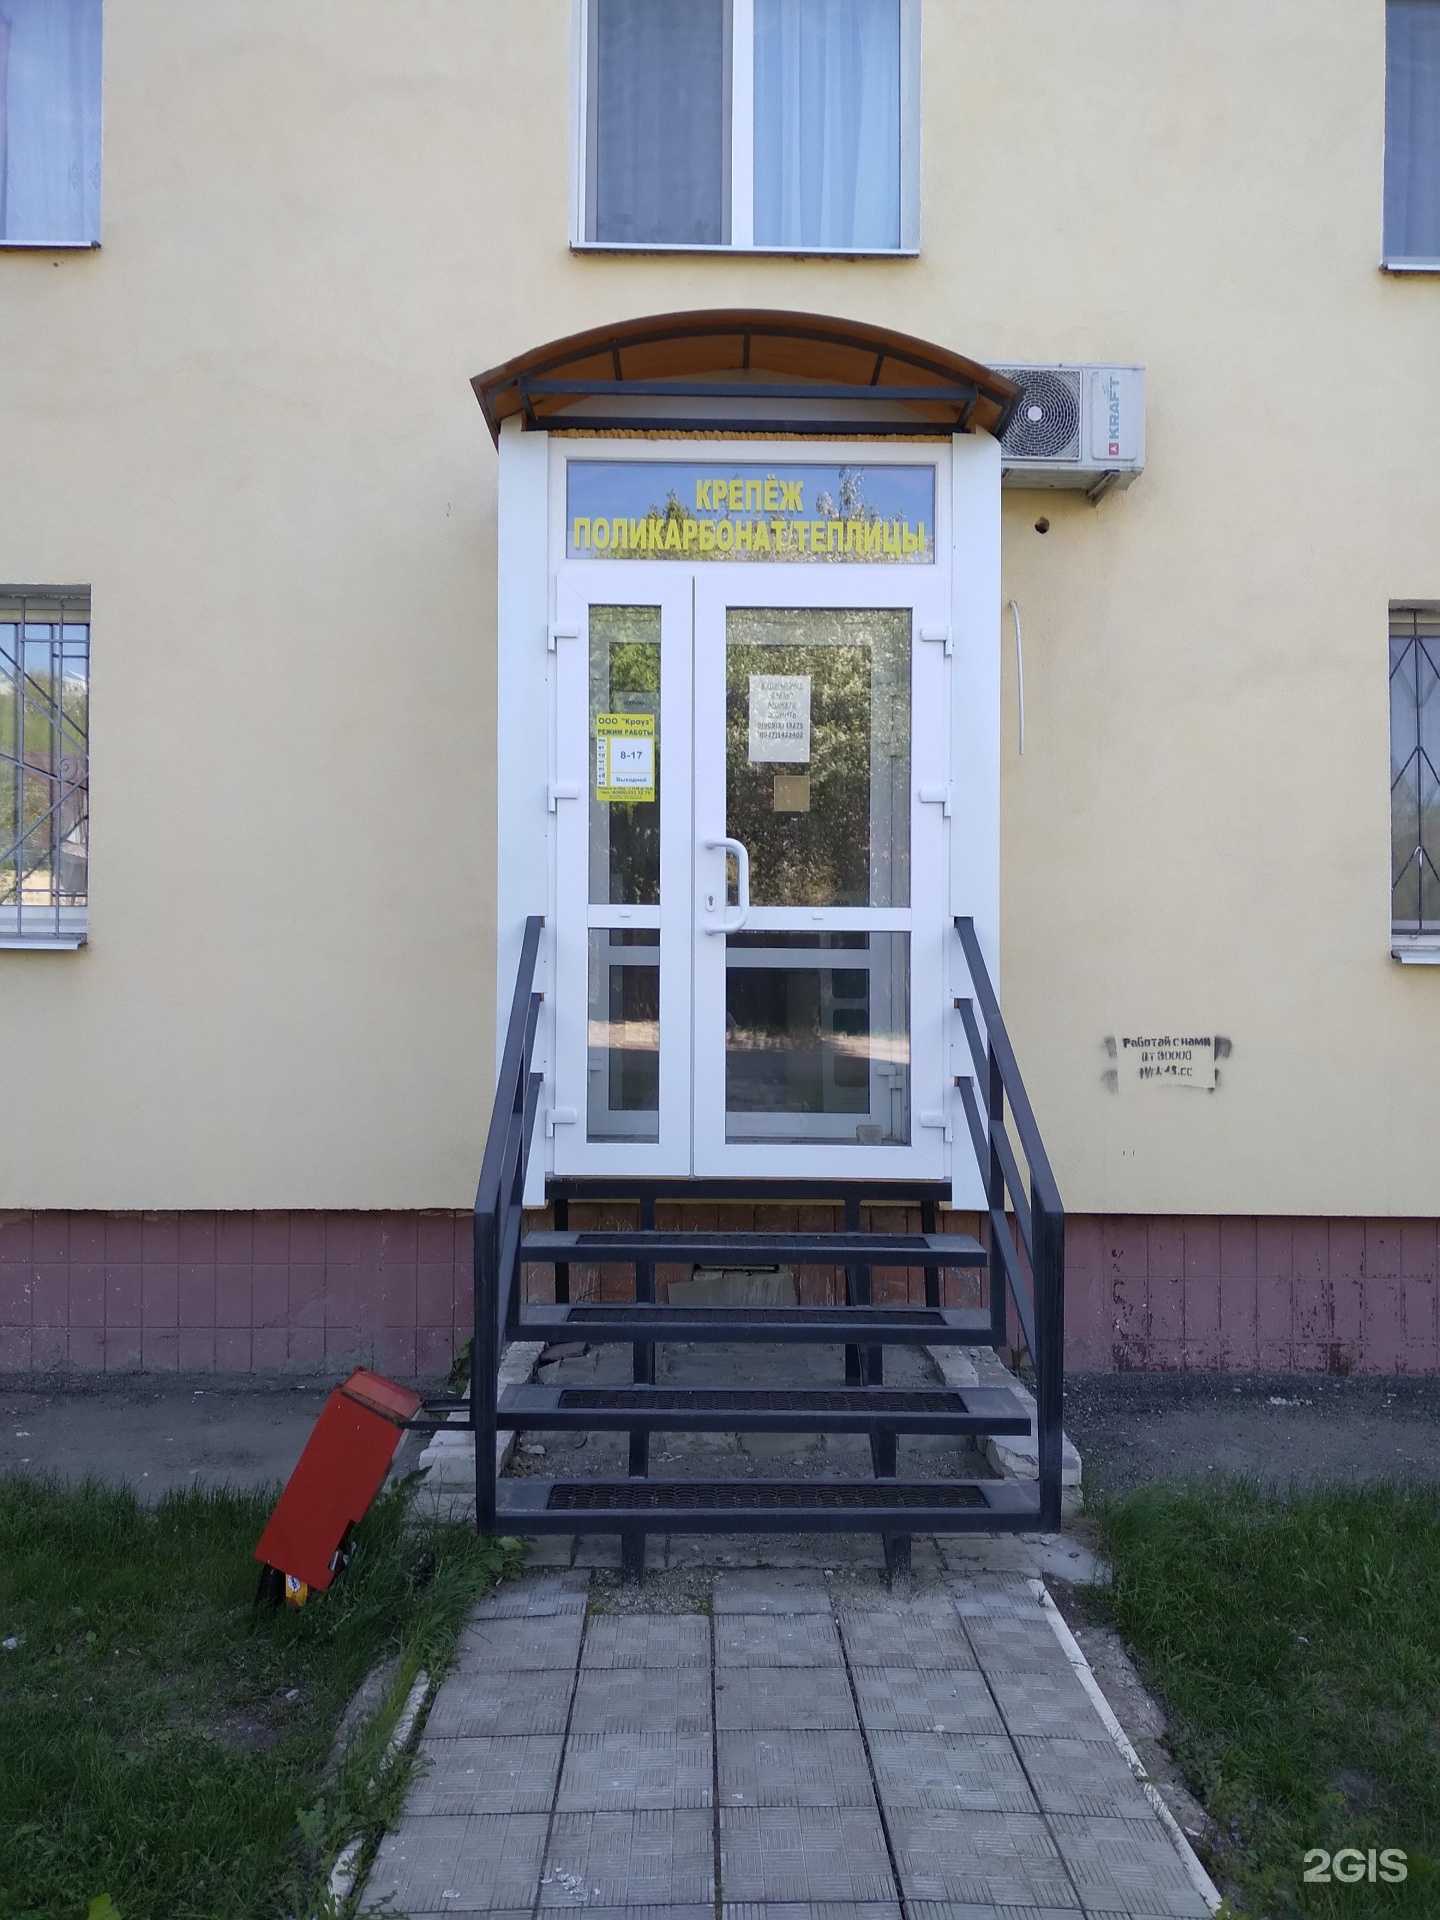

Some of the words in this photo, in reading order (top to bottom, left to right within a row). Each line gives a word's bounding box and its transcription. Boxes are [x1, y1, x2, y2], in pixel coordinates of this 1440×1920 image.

[1108, 376, 1120, 439] KRAFT
[696, 474, 804, 512] КРЕПЁЖ
[598, 717, 618, 725] ООО
[620, 751, 642, 760] 8-17
[1122, 1036, 1171, 1048] Работай
